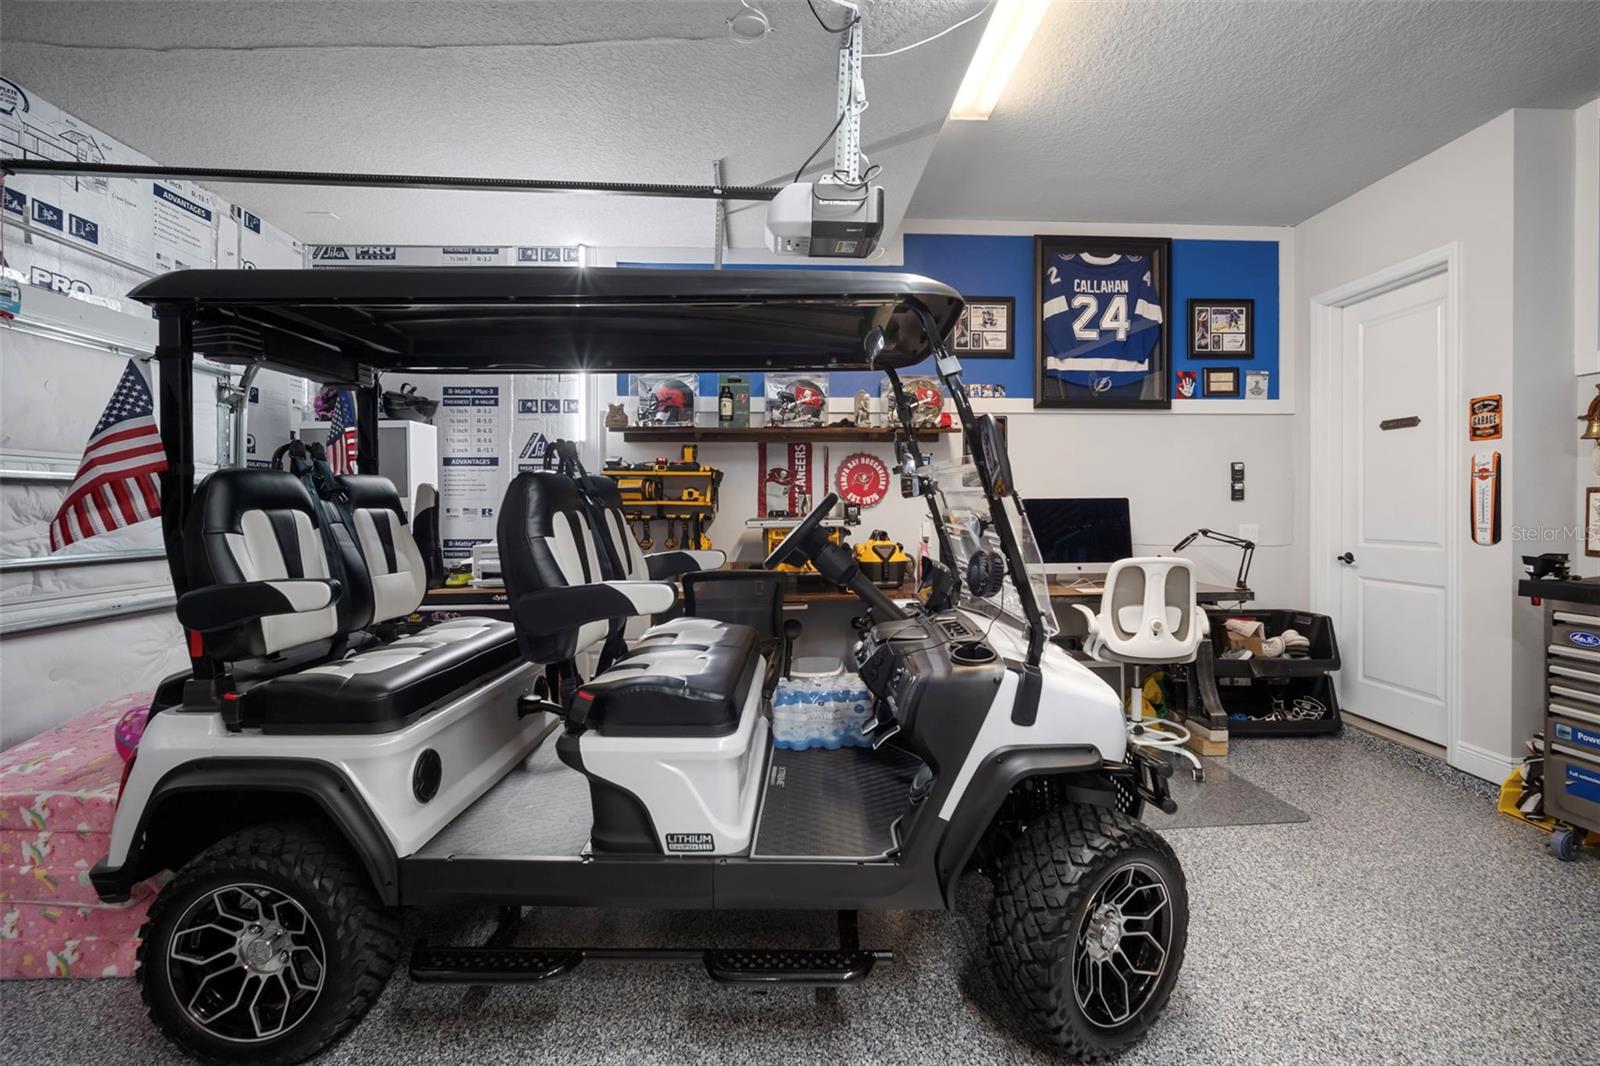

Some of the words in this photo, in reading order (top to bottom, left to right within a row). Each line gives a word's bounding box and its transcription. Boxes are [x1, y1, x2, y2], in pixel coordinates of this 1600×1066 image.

[163, 191, 206, 217] ADVANTAGES
[31, 265, 92, 296] PRO
[1047, 266, 1061, 285] 2
[1142, 270, 1151, 287] 4
[1074, 279, 1128, 293] CALLAHAN
[1071, 294, 1131, 341] 24
[1473, 414, 1497, 425] GARAGE
[668, 834, 711, 843] LITHIUM
